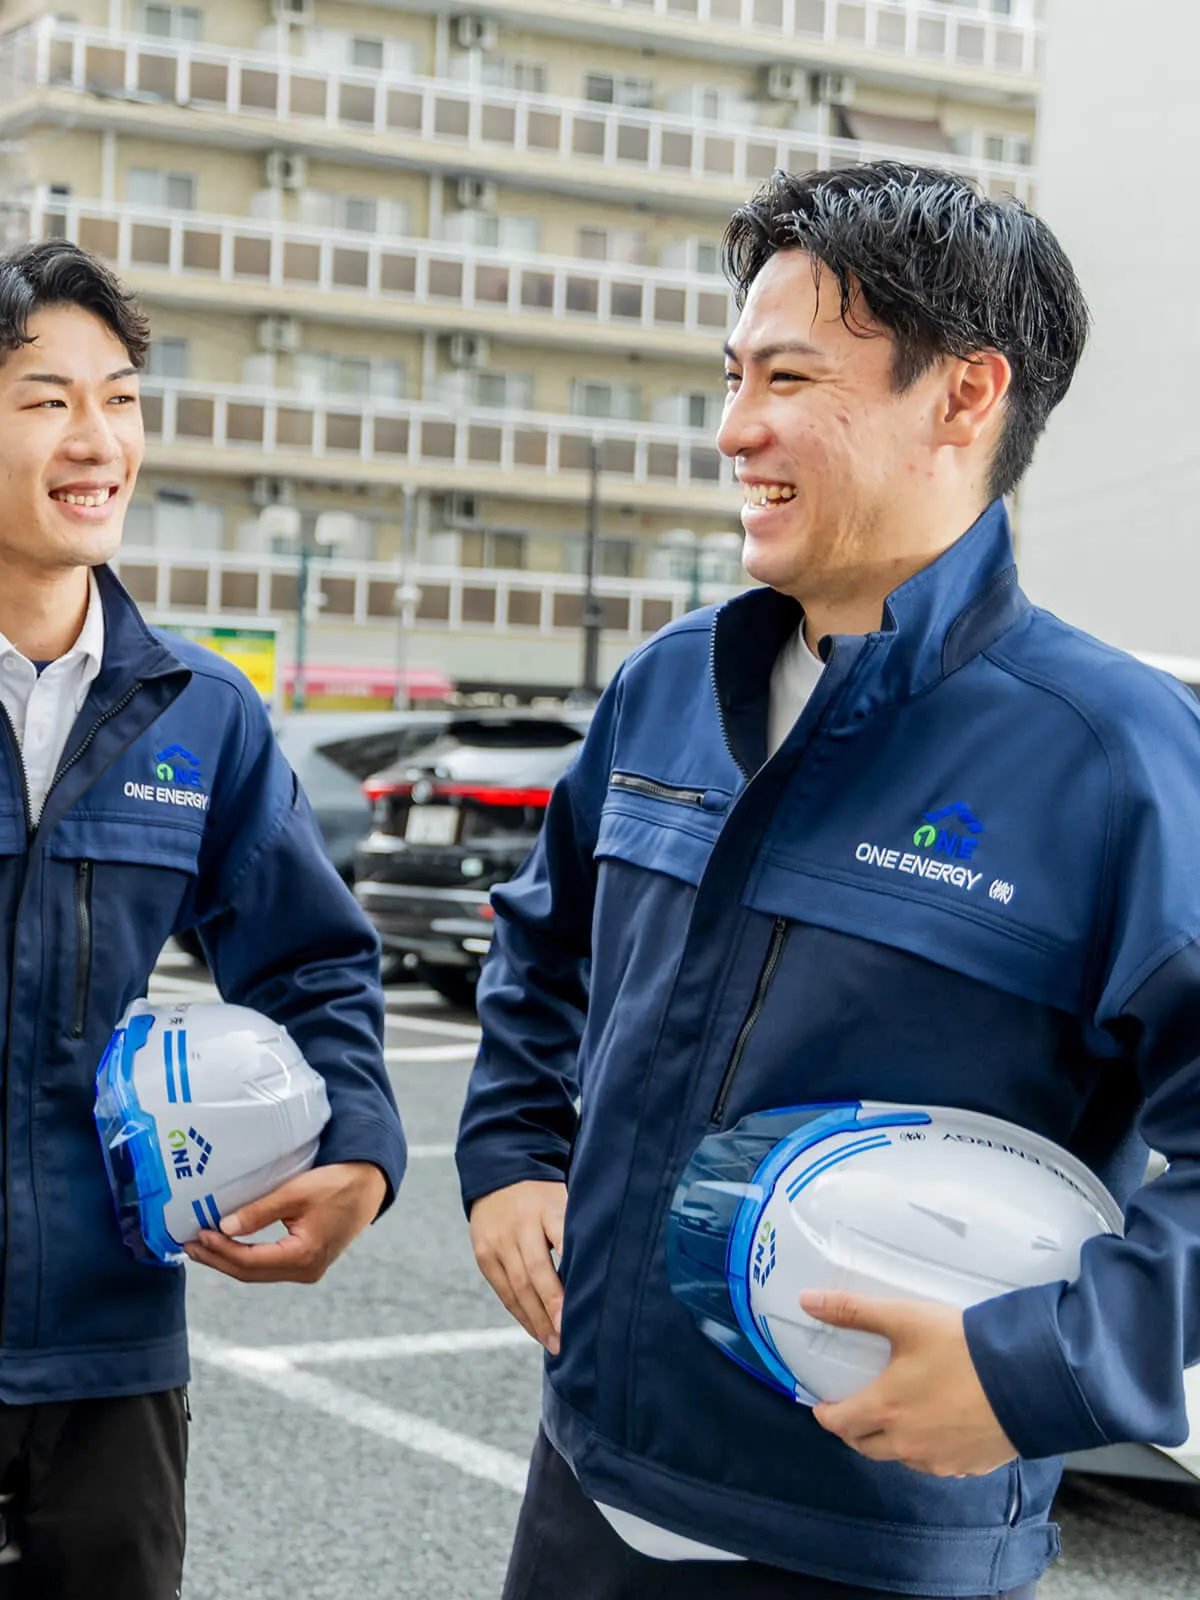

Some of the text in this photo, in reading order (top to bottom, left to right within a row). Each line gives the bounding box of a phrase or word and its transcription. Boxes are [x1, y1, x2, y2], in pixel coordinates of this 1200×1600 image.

[124, 781, 209, 811] ONE ENERGY
[855, 842, 900, 869] ONE
[899, 853, 983, 890] ENERGY
[168, 1129, 193, 1180] ONE
